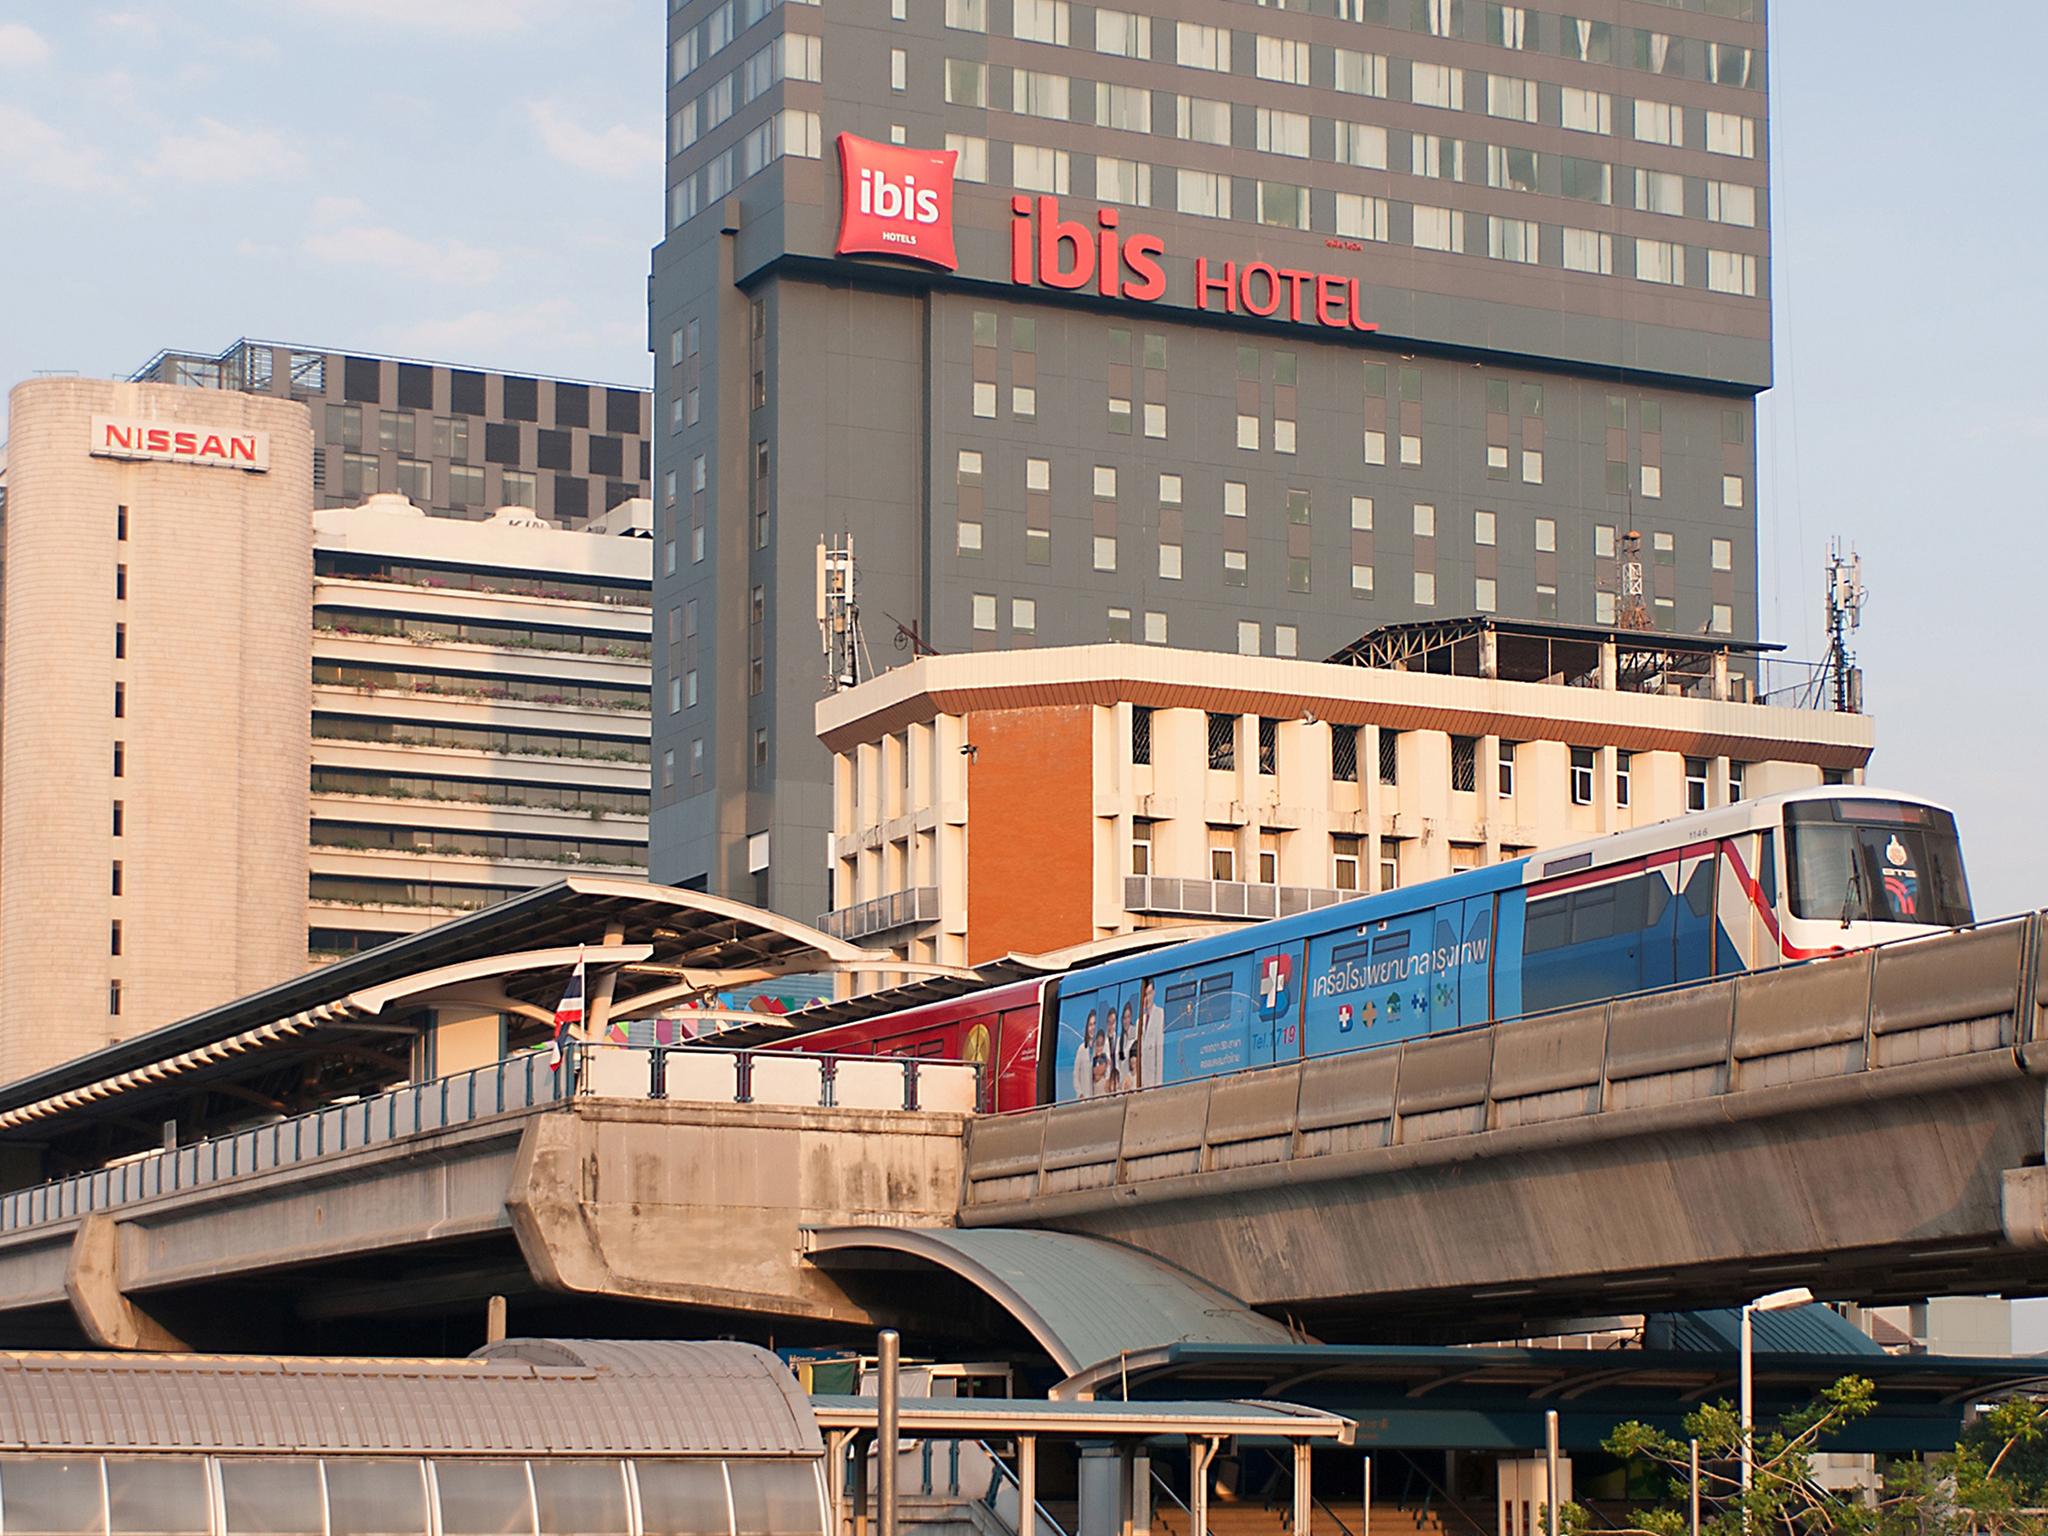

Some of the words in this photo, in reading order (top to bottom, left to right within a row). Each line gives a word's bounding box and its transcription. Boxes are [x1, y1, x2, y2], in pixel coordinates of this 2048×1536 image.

[860, 168, 940, 224] ibis
[882, 231, 917, 245] HOTELS
[1011, 195, 1167, 302] ibis
[1196, 257, 1379, 332] HOTEL
[106, 424, 256, 461] NISSAN
